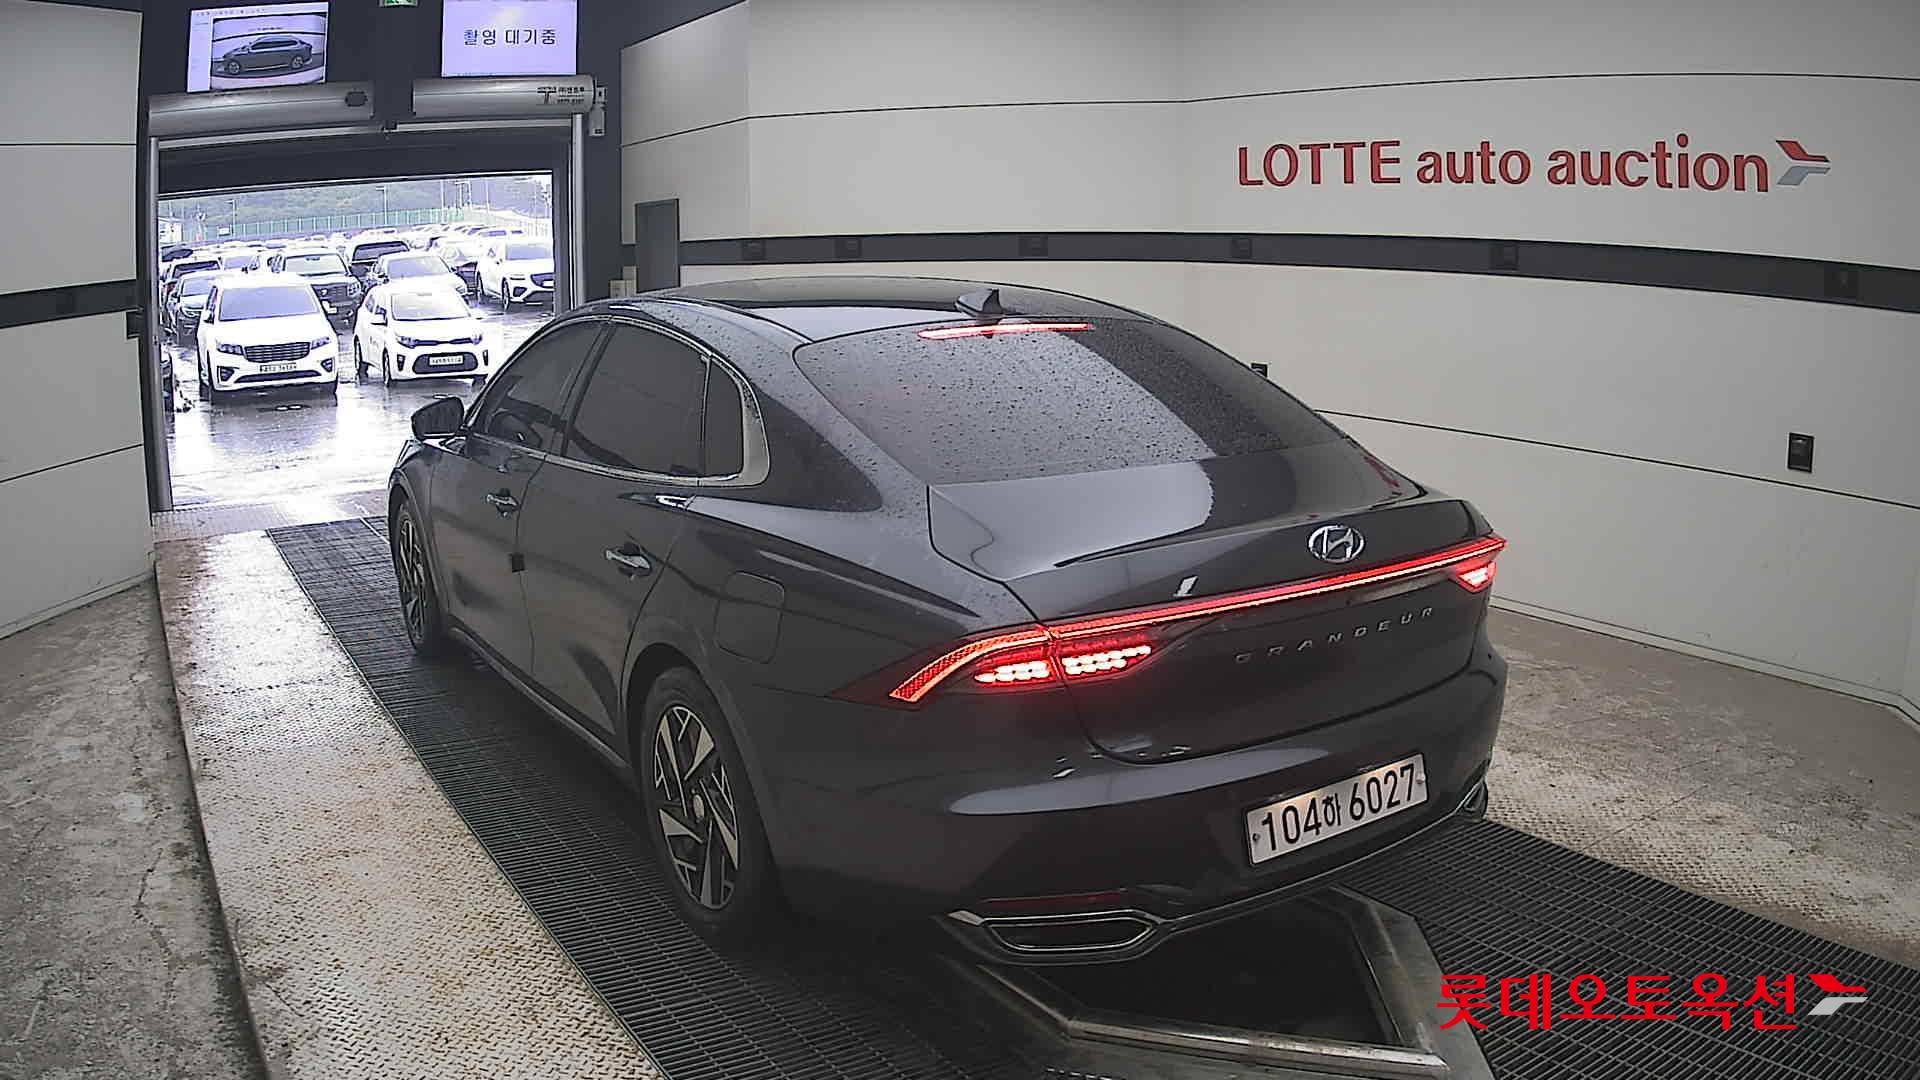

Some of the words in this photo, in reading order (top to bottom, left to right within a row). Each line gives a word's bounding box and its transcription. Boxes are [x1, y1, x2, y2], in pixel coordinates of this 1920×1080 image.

[463, 28, 496, 46] 촬영
[505, 28, 556, 45] 대기중
[1238, 140, 1401, 187] LOTTE
[1416, 140, 1532, 187] auto
[1547, 133, 1769, 193] auction
[1236, 606, 1433, 664] GRANDEUR
[1349, 763, 1415, 822] 6027
